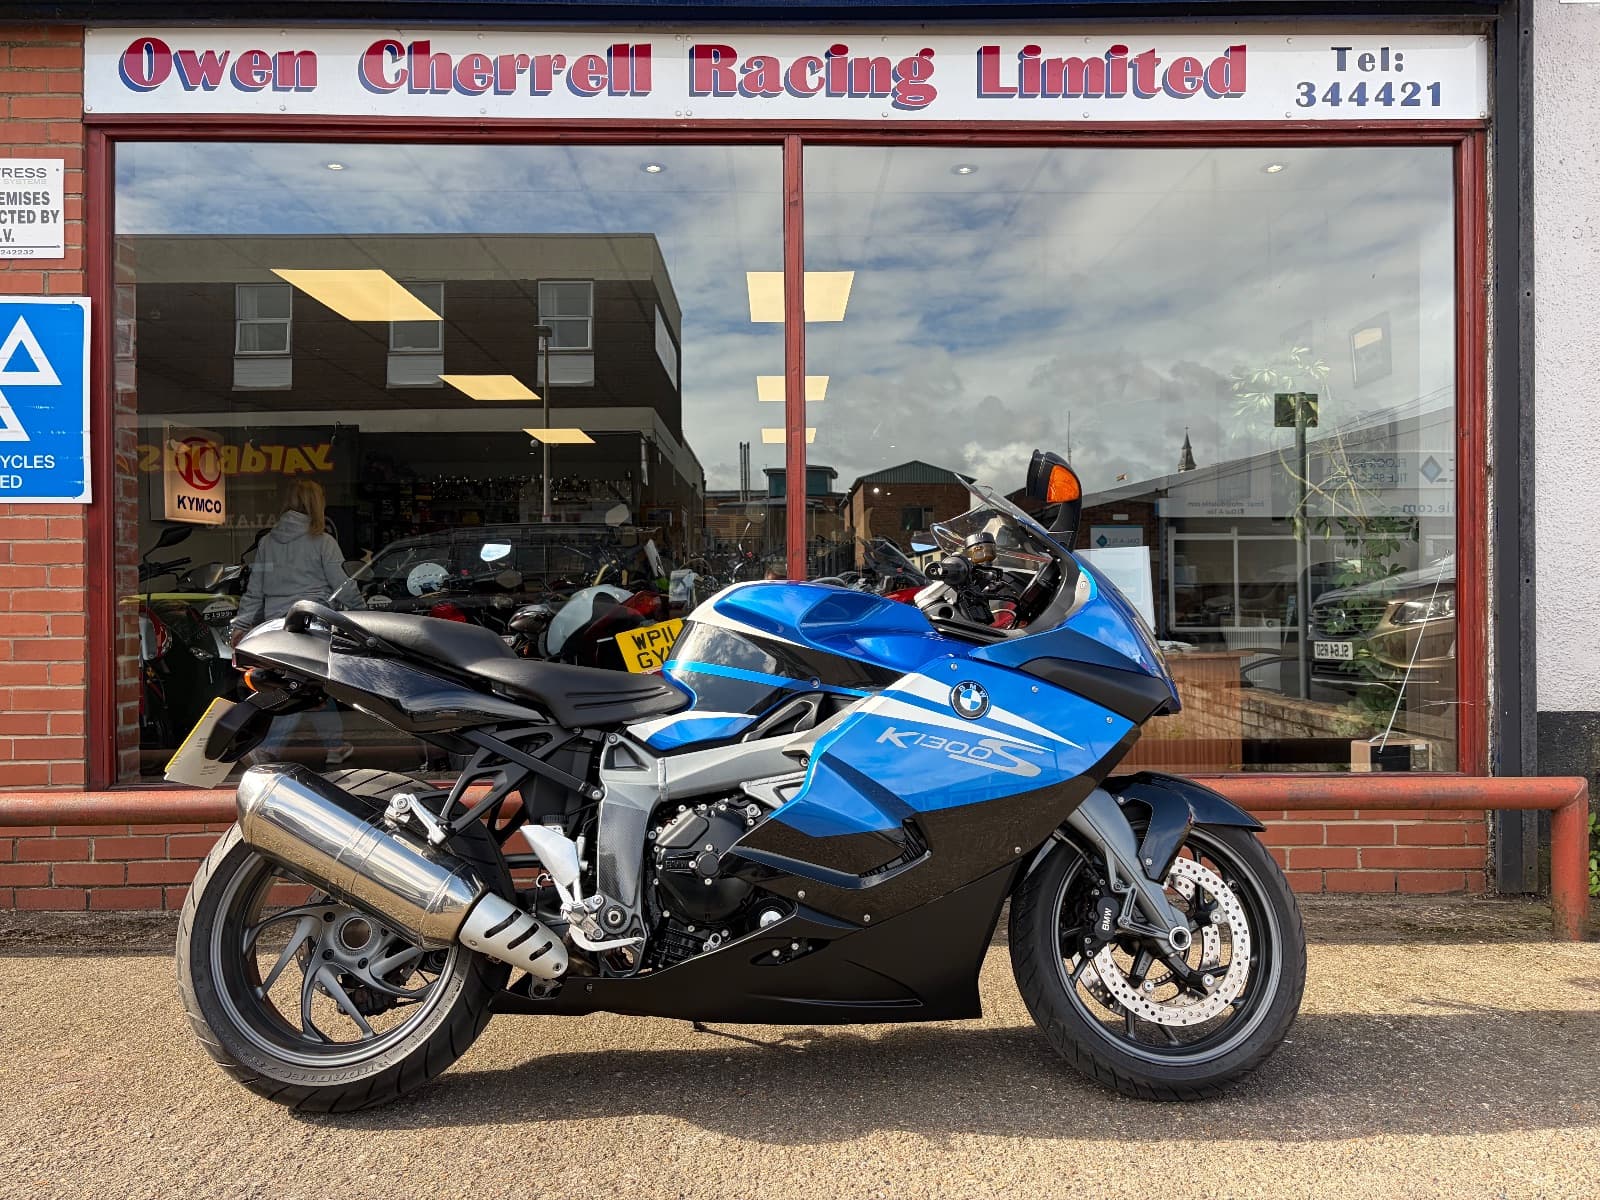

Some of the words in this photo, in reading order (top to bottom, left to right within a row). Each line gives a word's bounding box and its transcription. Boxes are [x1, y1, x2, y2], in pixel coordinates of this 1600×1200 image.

[1331, 46, 1404, 72] Tel:
[118, 36, 318, 93] Owen
[358, 39, 652, 97] Cherrell
[688, 43, 938, 111] Racing
[976, 44, 1247, 99] Limited
[1295, 81, 1441, 107] 344421
[0, 167, 47, 178] RESS
[40, 210, 60, 223] BY
[0, 454, 55, 469] YCLES
[177, 494, 222, 514] KYMCO
[1101, 907, 1113, 931] BMW
